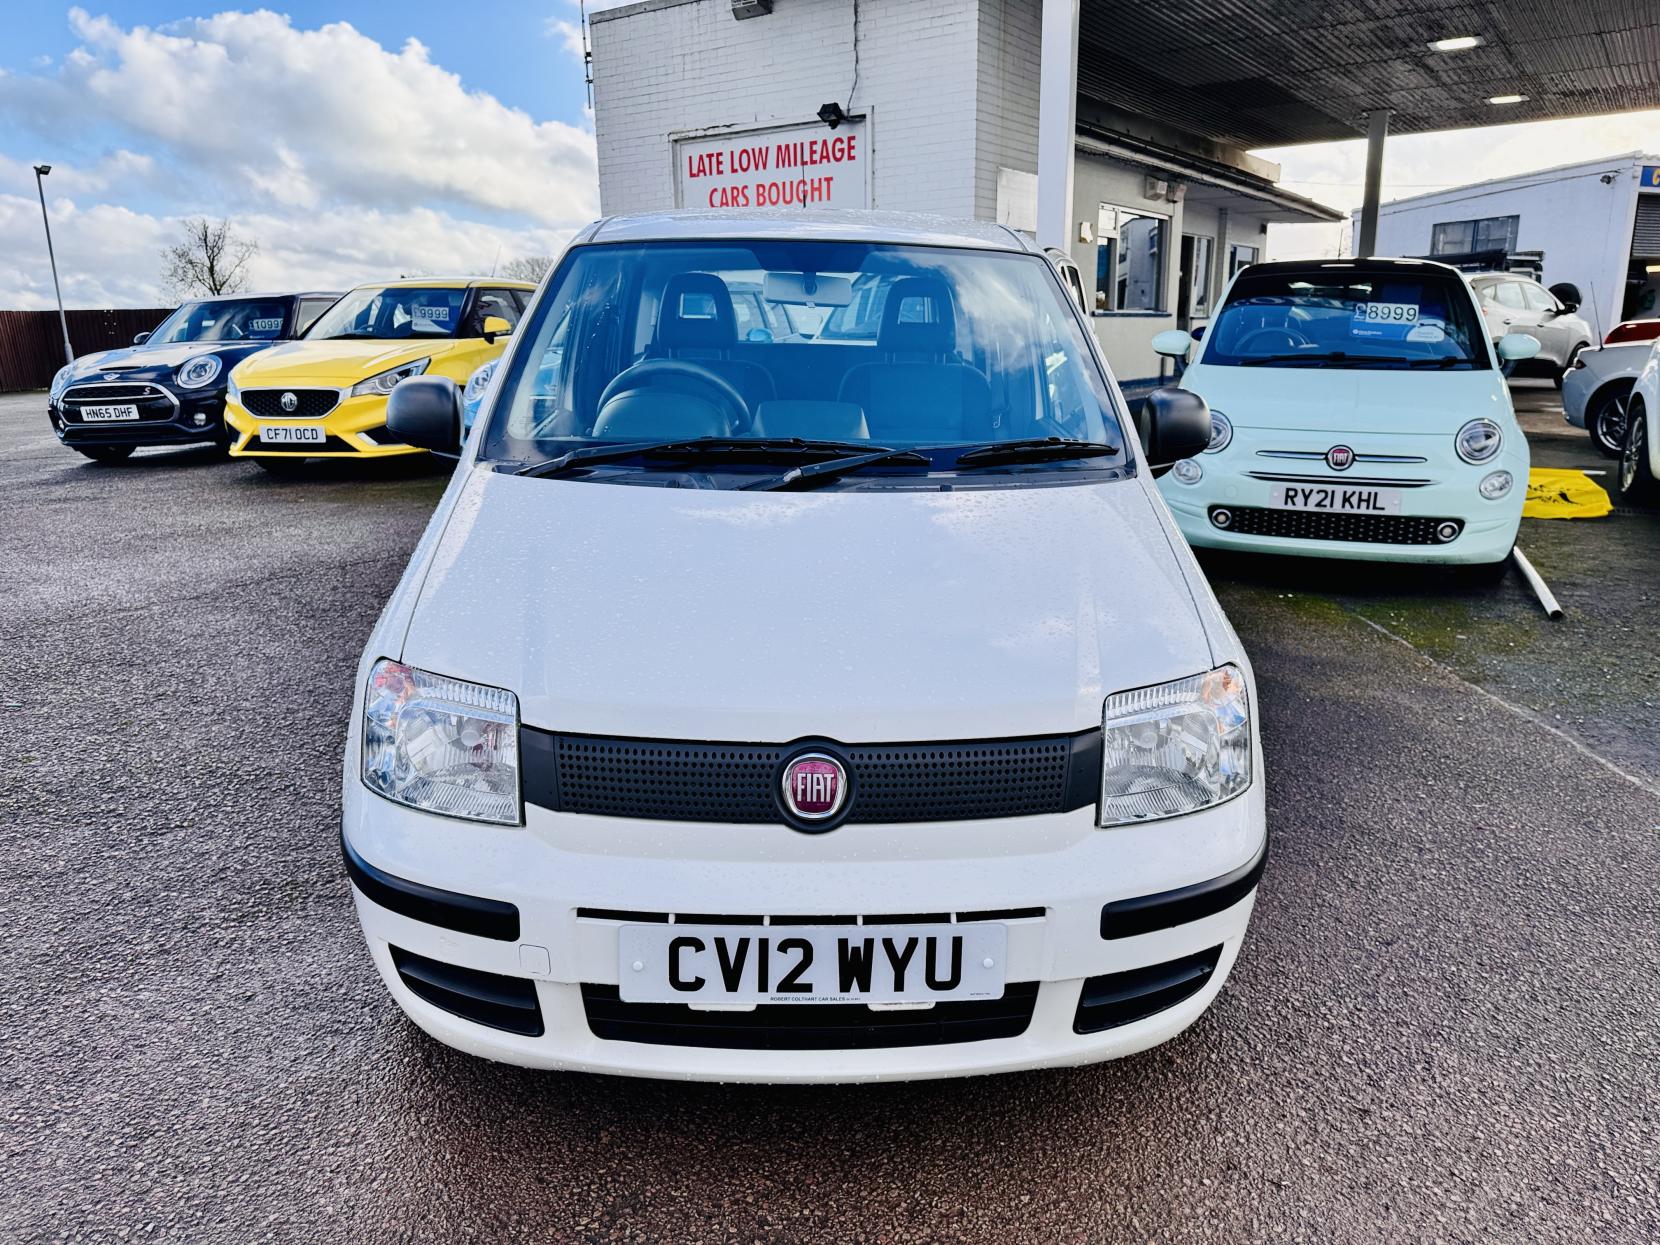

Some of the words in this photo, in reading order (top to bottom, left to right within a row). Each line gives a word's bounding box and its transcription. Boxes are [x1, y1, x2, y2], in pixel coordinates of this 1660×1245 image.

[688, 152, 724, 178] LATE
[730, 146, 770, 174] LOW
[776, 135, 856, 169] MILEAGE
[709, 185, 750, 208] CARS
[756, 176, 834, 207] BOUGHT
[85, 407, 112, 419] HN65
[113, 406, 133, 418] DHF
[266, 428, 292, 440] CF71
[295, 428, 318, 440] OCD
[1333, 452, 1348, 464] FIAT
[1284, 487, 1336, 508] RY21
[1341, 490, 1386, 511] KHL
[797, 773, 835, 803] FIAT
[668, 936, 814, 993] CV12
[837, 936, 963, 993] WYU
